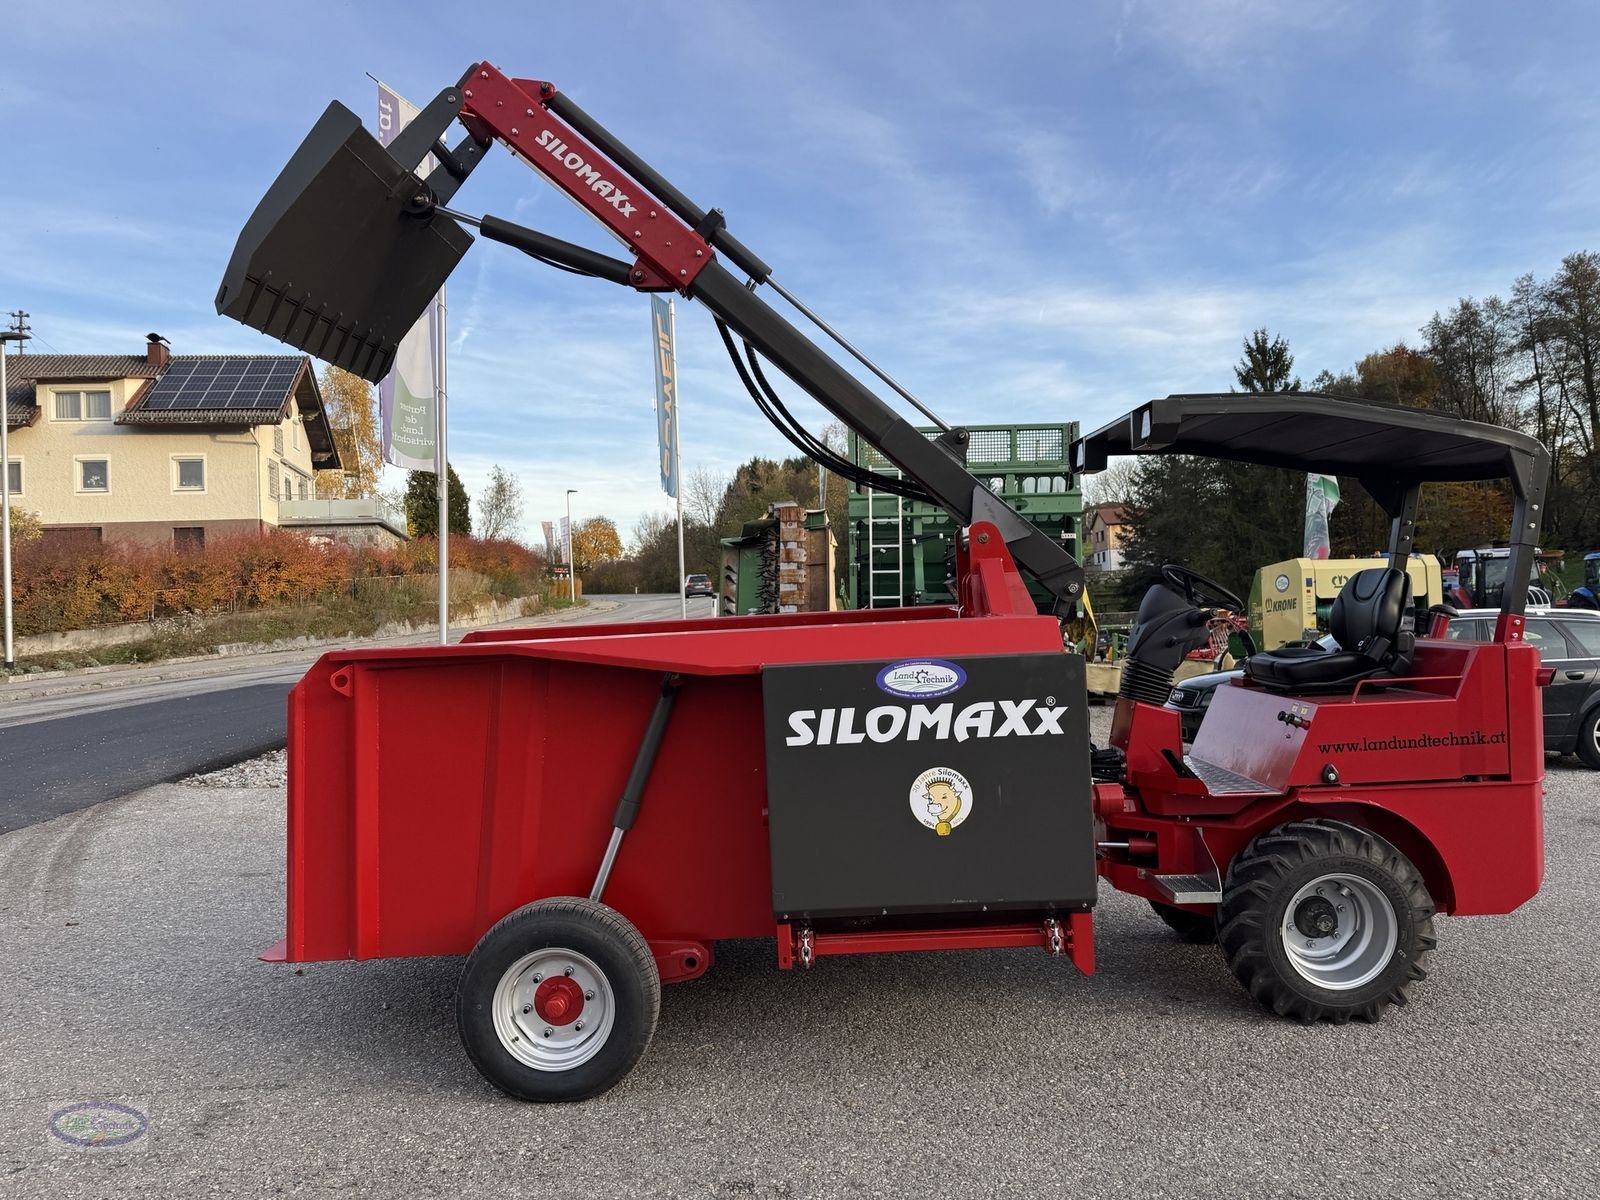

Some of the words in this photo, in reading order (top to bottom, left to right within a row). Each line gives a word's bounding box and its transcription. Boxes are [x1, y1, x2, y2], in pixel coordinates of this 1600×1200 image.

[1272, 598, 1297, 612] KRONE
[894, 671, 915, 680] Land
[922, 674, 953, 684] Technik
[1318, 731, 1506, 754] www.landundtechnik.at
[937, 768, 969, 790] Silomaxx
